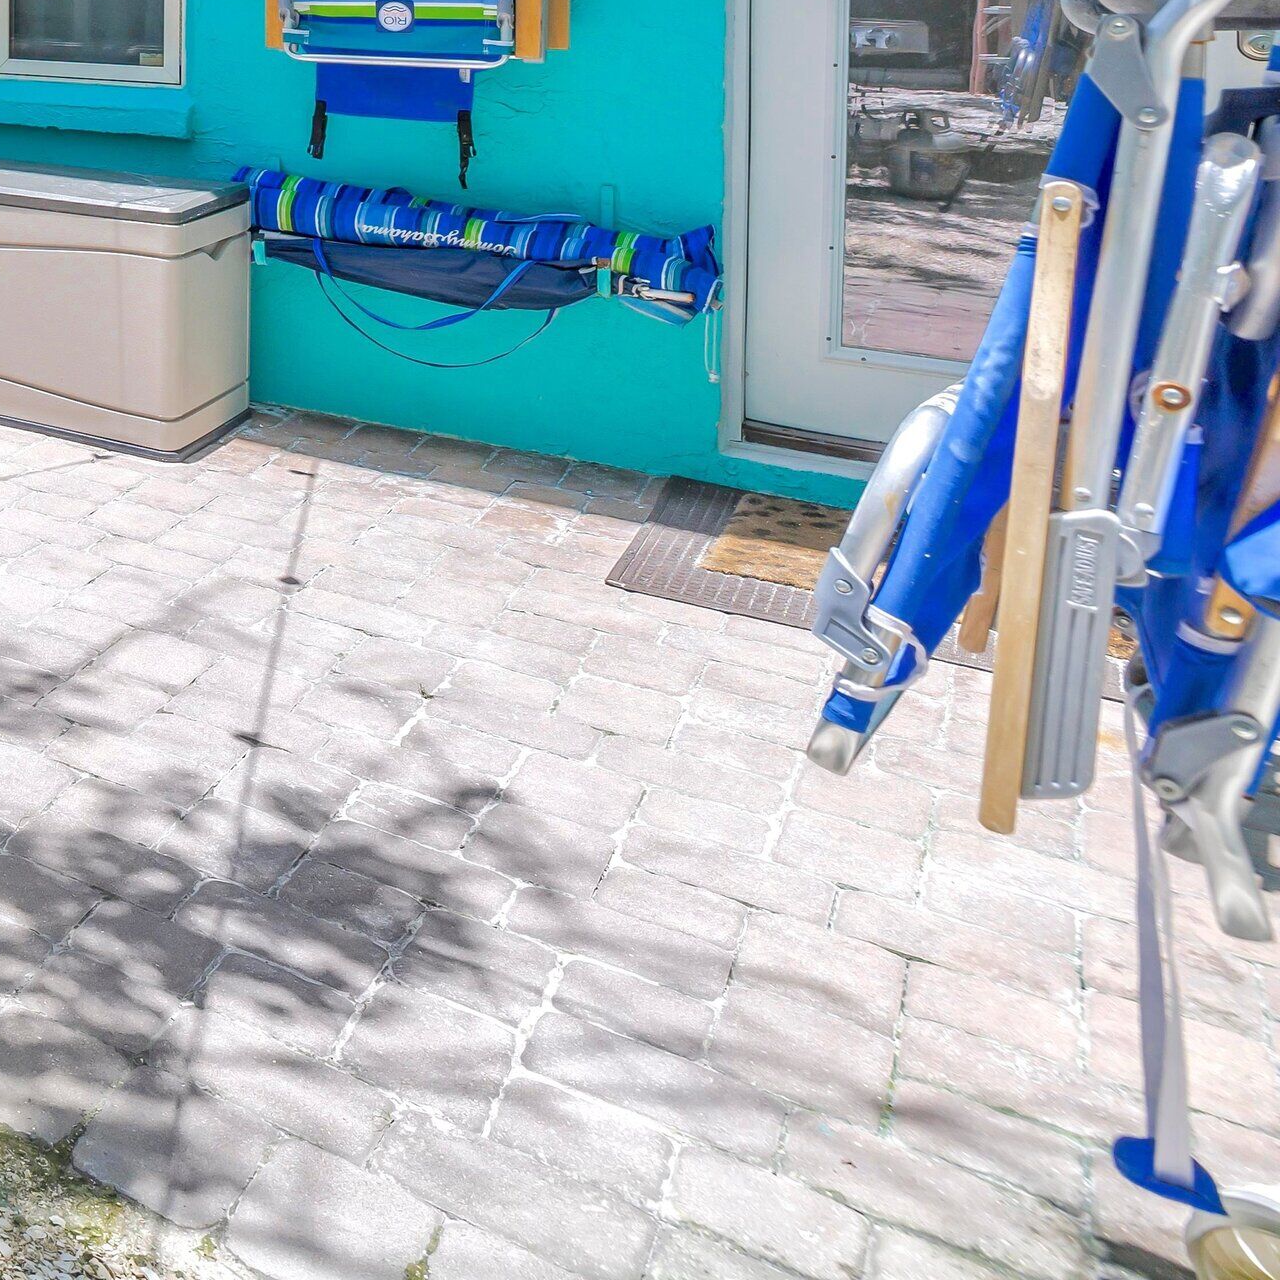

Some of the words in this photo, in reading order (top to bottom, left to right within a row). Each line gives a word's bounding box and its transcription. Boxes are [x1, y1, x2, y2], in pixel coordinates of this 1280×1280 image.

[383, 16, 407, 26] RIO
[361, 224, 445, 248] Bahama
[446, 230, 519, 257] Tommy
